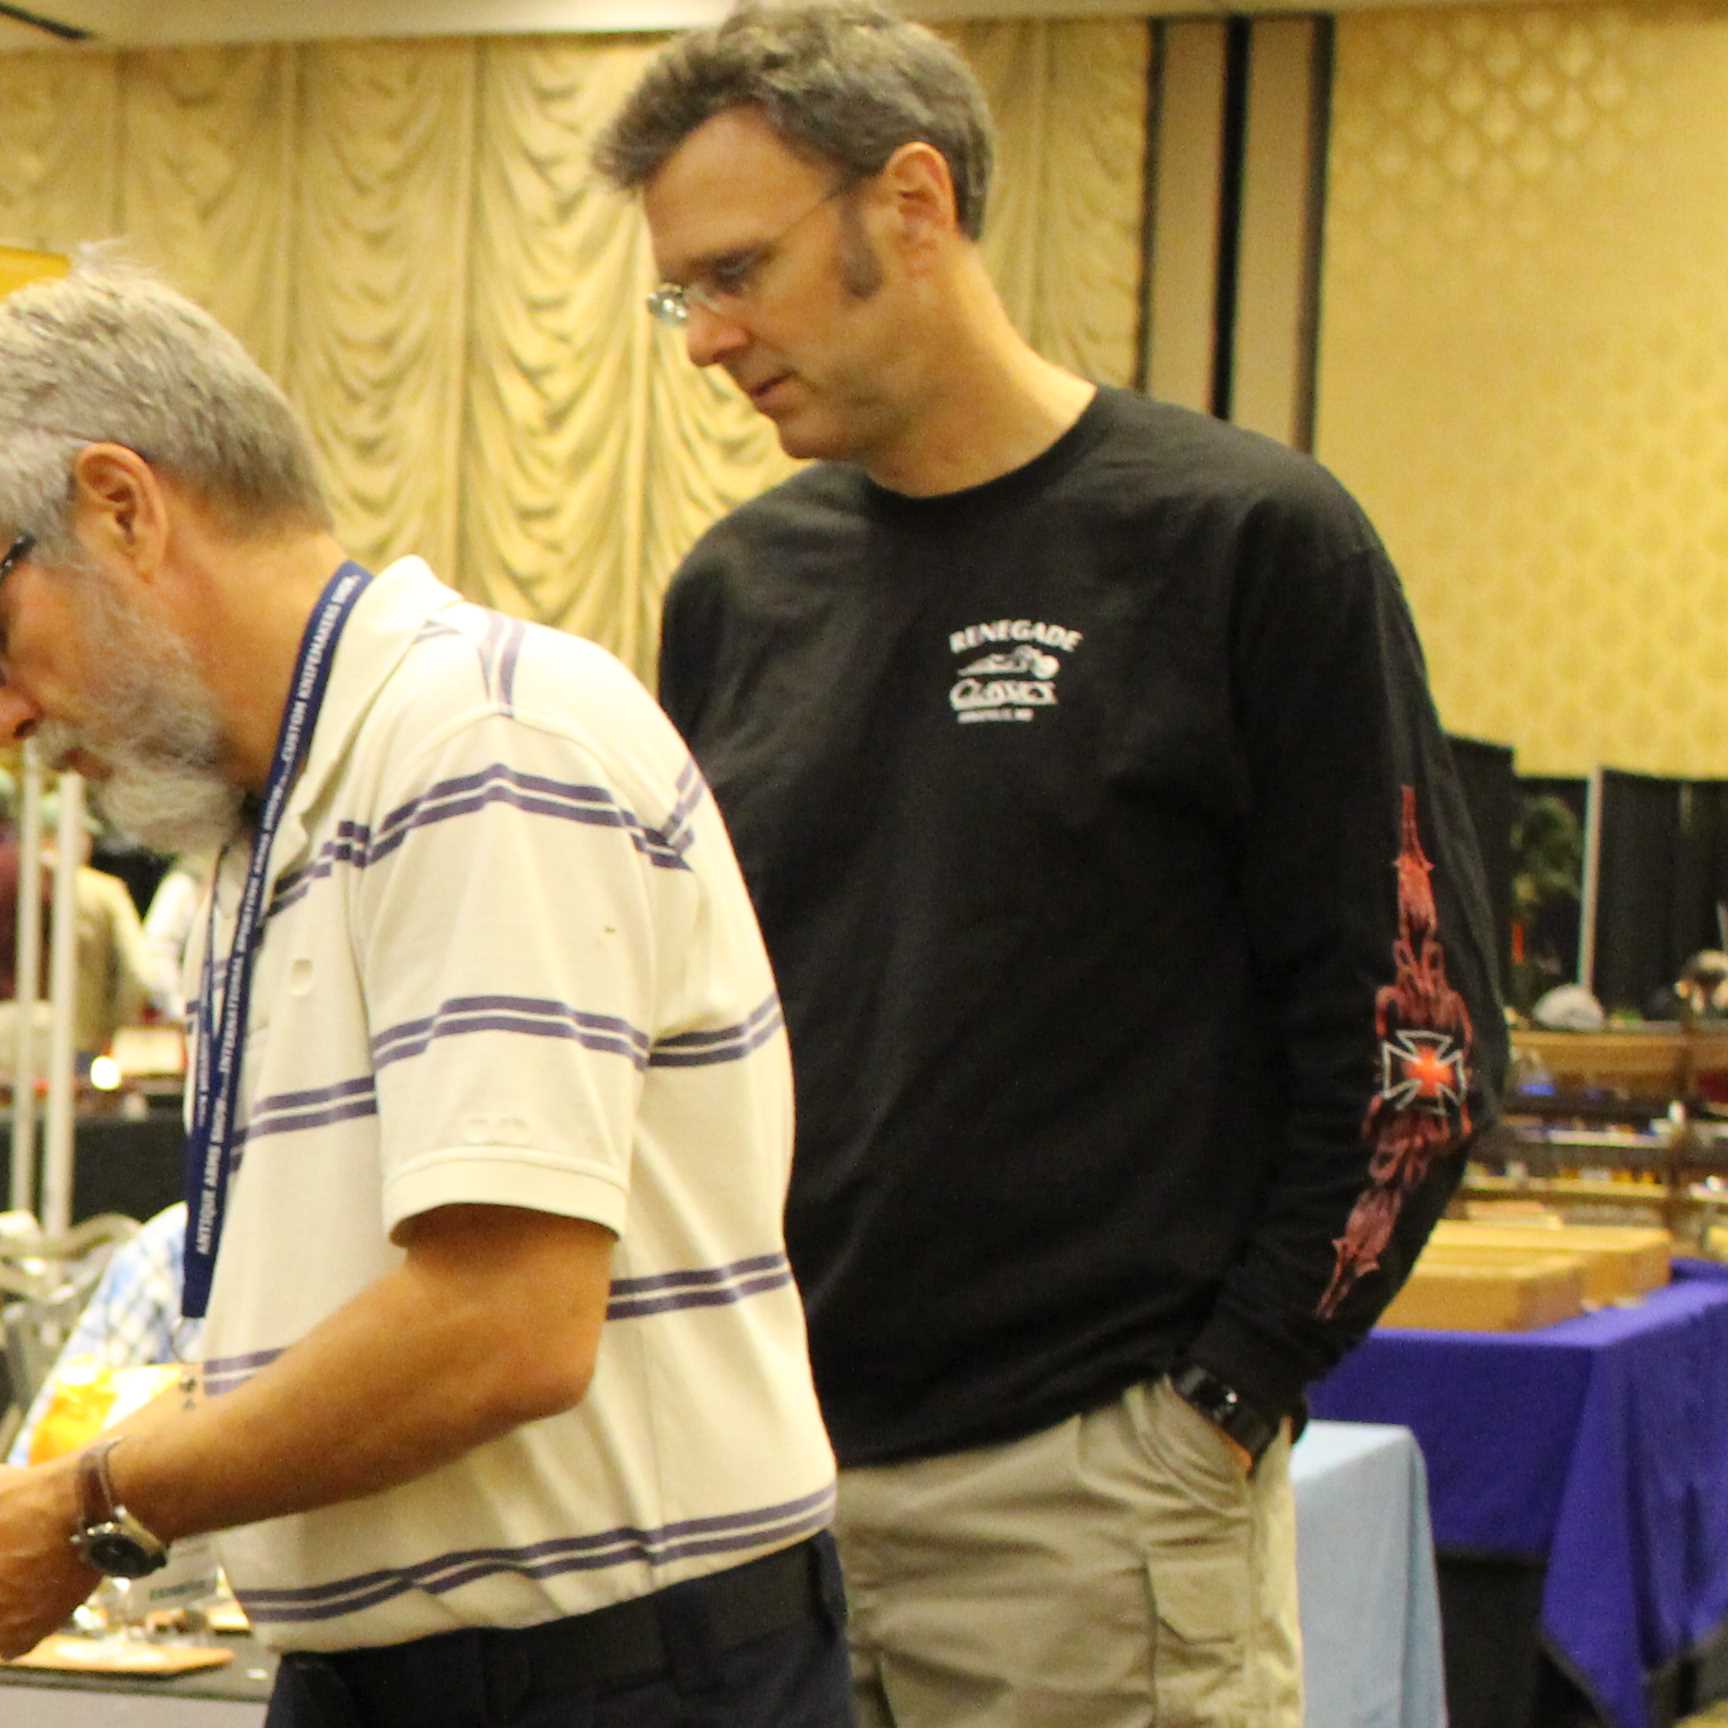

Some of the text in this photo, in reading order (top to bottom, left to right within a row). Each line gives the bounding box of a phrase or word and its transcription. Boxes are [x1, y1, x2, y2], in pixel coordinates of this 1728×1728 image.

[949, 619, 1084, 654] RENEGADE
[219, 957, 245, 1073] INTERNATIONAL
[282, 701, 307, 763] CUSTOM
[299, 603, 342, 699] KNIFEMAKERS
